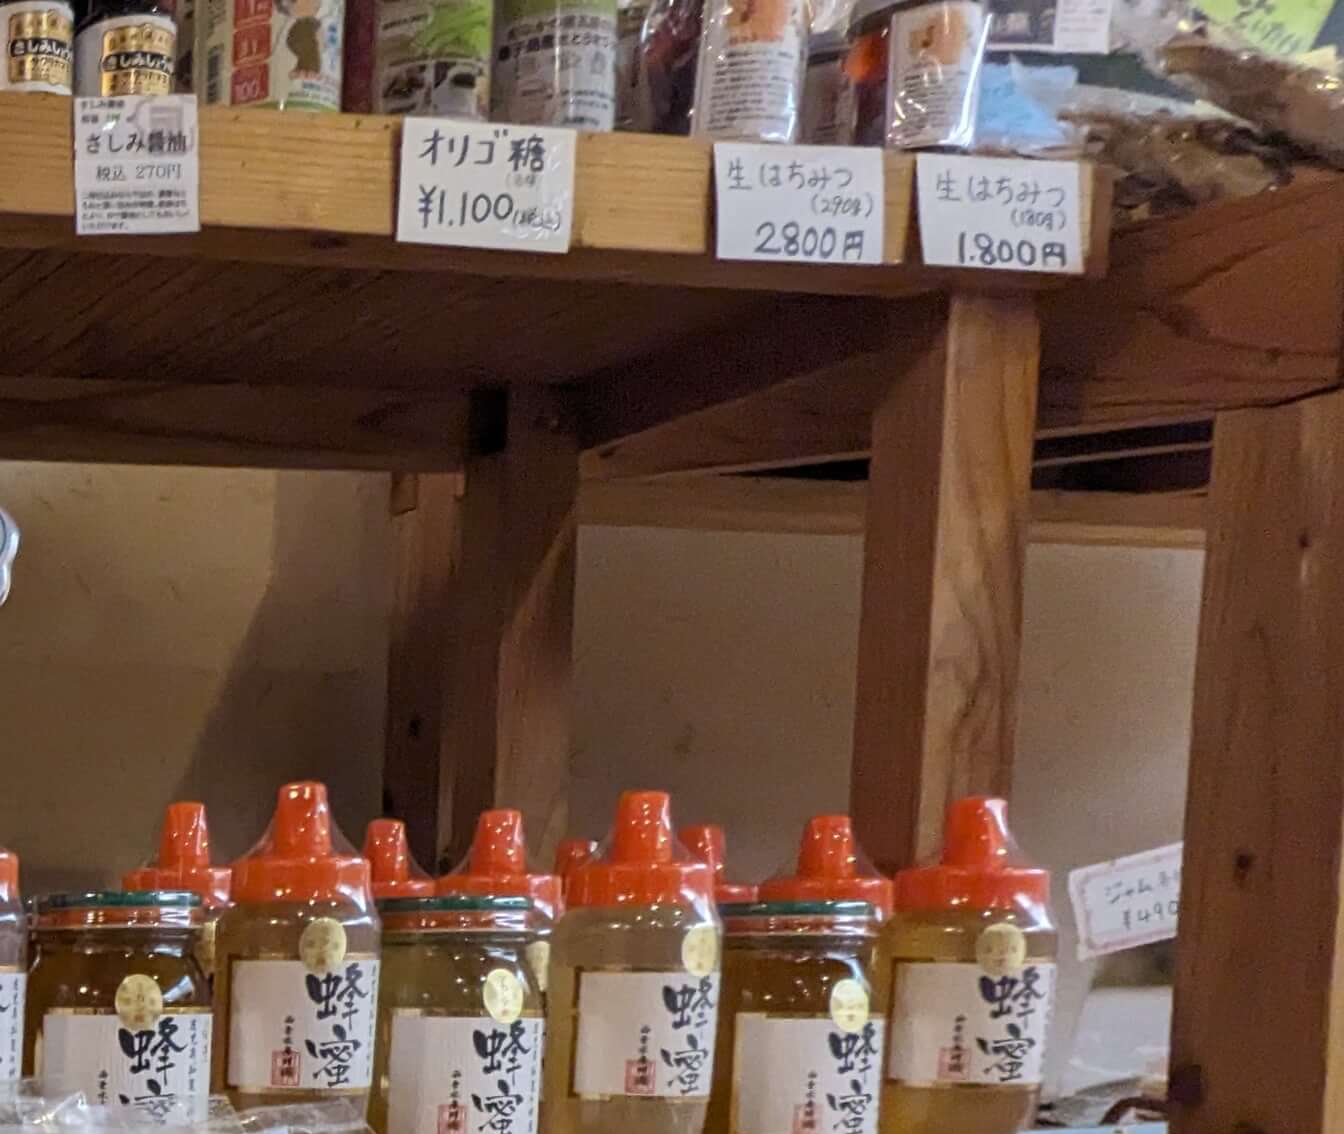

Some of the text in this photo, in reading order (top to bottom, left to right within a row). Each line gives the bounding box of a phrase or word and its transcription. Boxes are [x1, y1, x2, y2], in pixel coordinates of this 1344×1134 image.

[86, 130, 188, 154] さしみ醤油
[418, 128, 547, 172] オリゴ糖
[96, 163, 182, 181] 税込 270円
[726, 160, 854, 190] 生はちみつ
[935, 172, 1067, 209] 生はちみつ
[752, 221, 865, 258] 2800円
[304, 962, 370, 1088] 蜂蜜
[660, 975, 716, 1096] 蜂蜜
[976, 970, 1046, 1084] 蜂蜜
